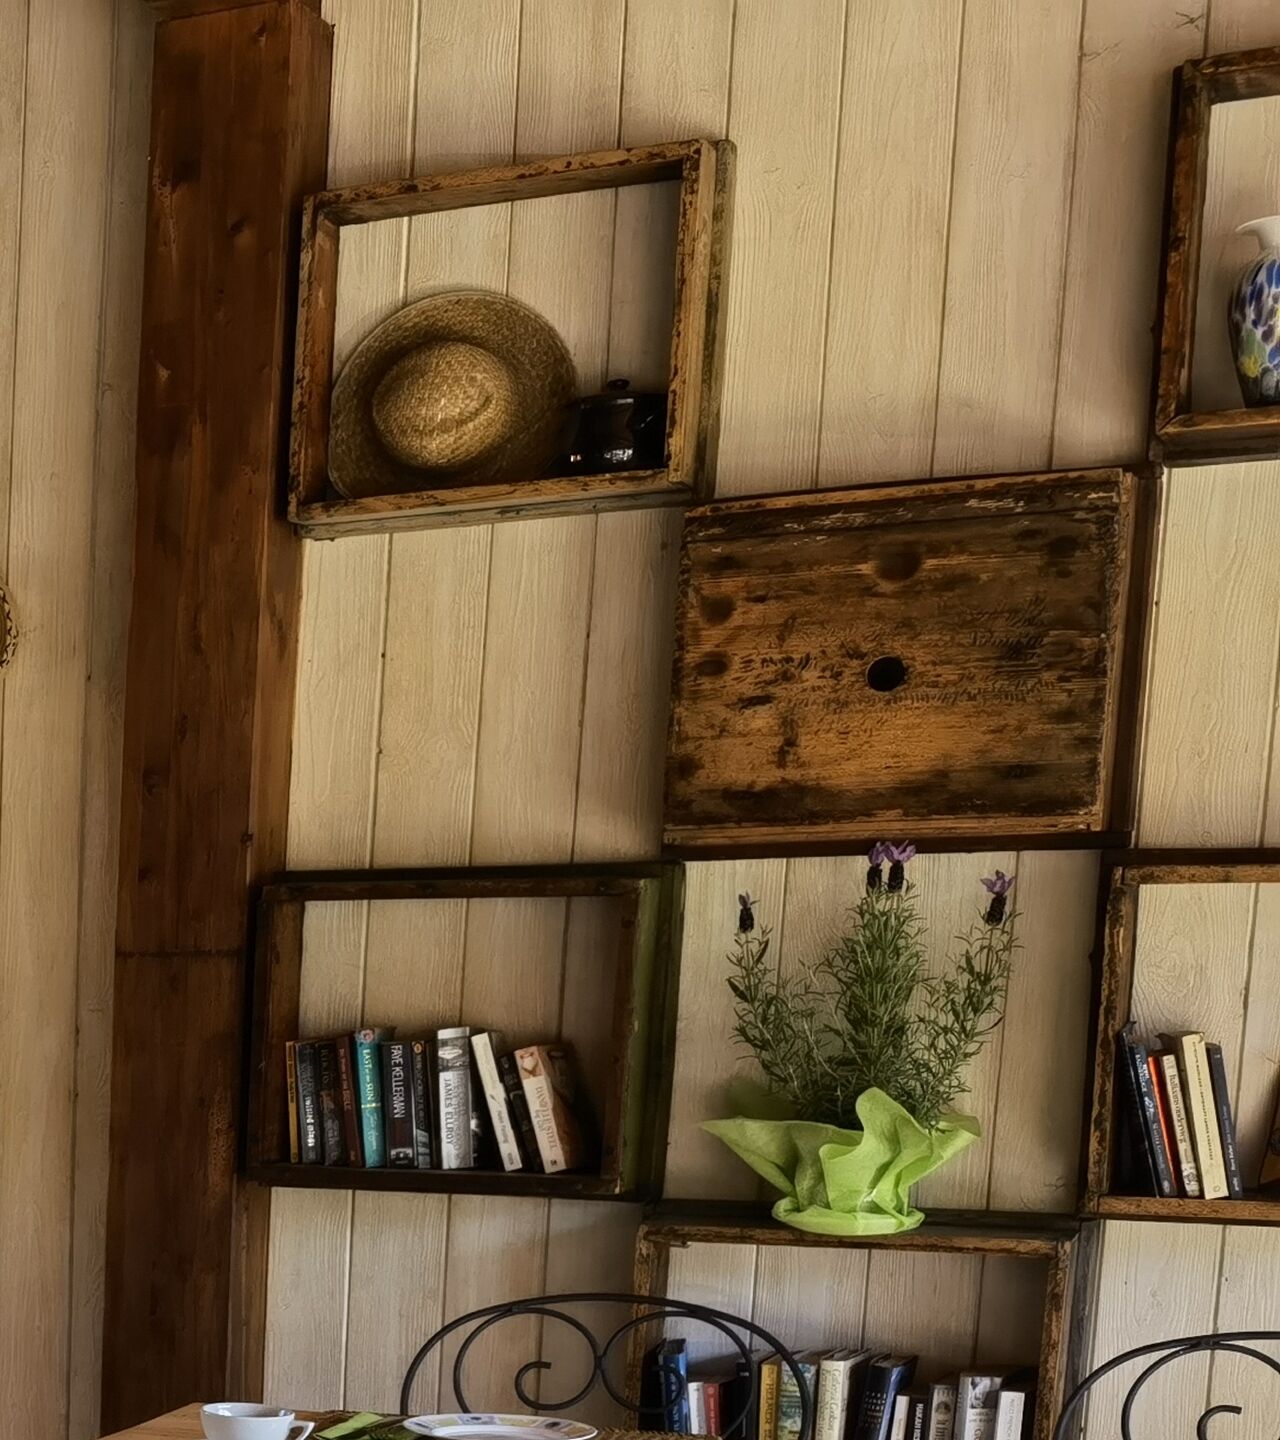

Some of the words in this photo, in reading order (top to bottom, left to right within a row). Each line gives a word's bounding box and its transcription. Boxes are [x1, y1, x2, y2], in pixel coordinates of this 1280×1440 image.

[389, 1044, 403, 1065] FAYE
[390, 1066, 406, 1118] KELLERMAN
[443, 1078, 452, 1108] JAMES
[444, 1111, 454, 1145] ELLROY
